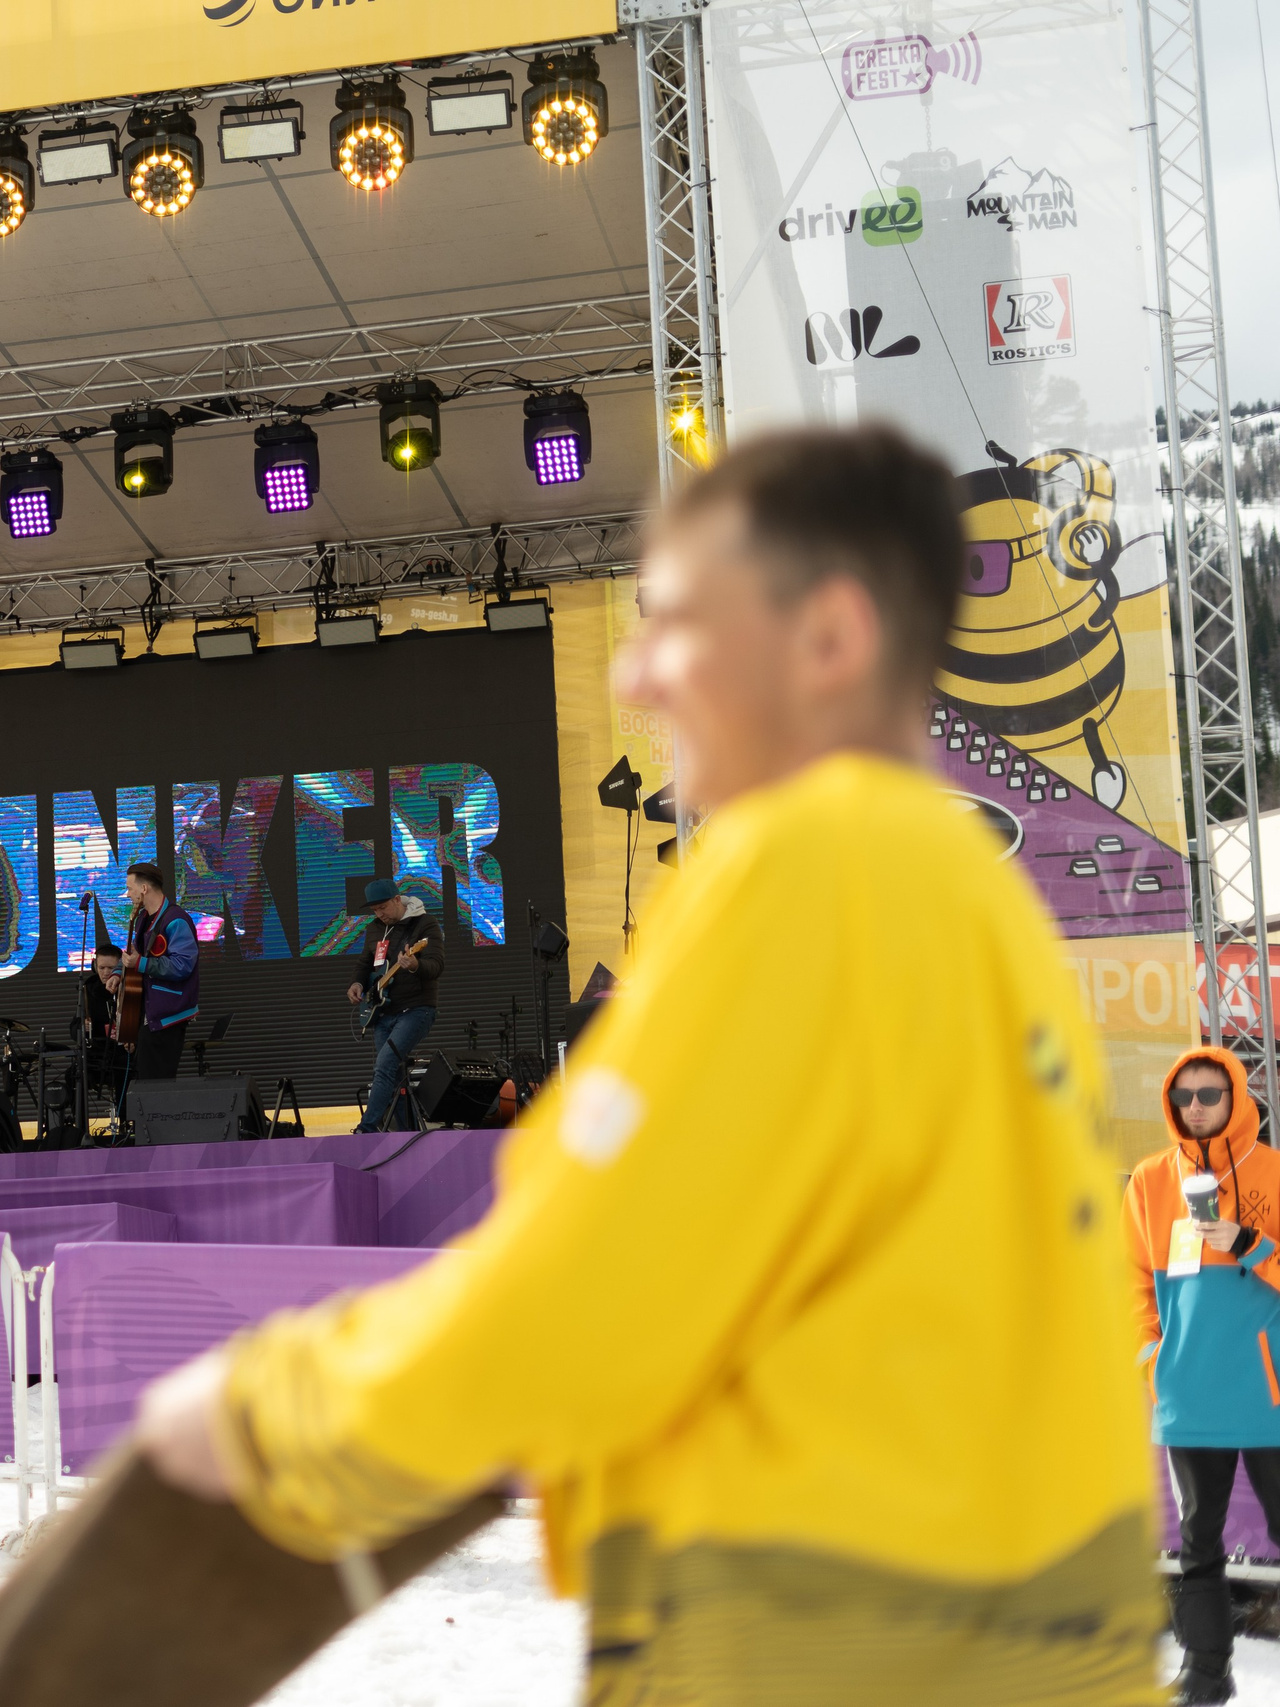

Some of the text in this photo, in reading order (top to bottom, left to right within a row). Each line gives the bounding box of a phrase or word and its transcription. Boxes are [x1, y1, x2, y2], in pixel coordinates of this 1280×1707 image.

[854, 43, 921, 69] GRELKA
[856, 69, 900, 92] FEST
[966, 189, 1075, 218] MOUNTAIN
[778, 196, 924, 242] drivee
[1028, 209, 1078, 231] MAN
[991, 343, 1071, 361] ROSTIC'S
[410, 606, 458, 623] spa-gesh.ru
[608, 778, 625, 790] SHURE
